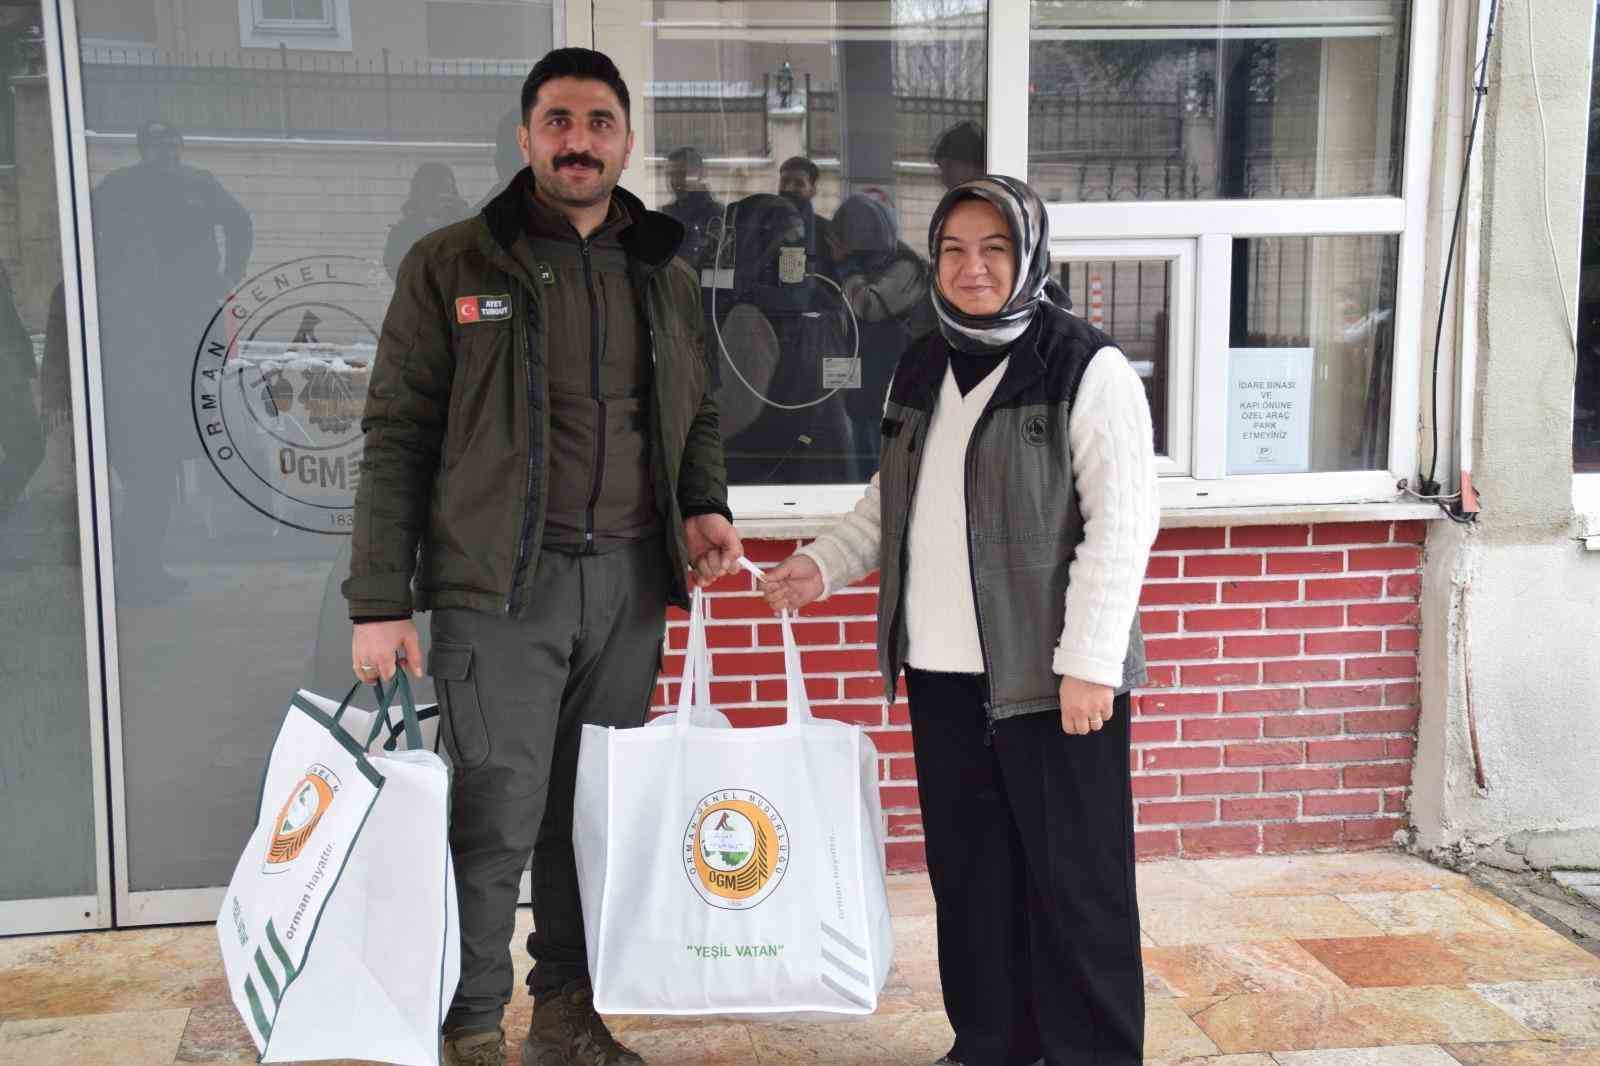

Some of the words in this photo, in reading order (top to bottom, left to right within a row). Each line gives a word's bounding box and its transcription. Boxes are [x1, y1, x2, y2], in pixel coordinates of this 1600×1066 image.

[200, 341, 233, 461] ORMAN
[231, 263, 337, 320] GENEL
[1240, 401, 1260, 409] KAPI
[1260, 391, 1273, 400] VE
[1253, 422, 1278, 430] PARK
[279, 447, 346, 490] OGM
[685, 822, 698, 876] ORMAN
[709, 870, 736, 891] OGM
[285, 893, 311, 940] orman
[735, 943, 785, 958] VATAN"
